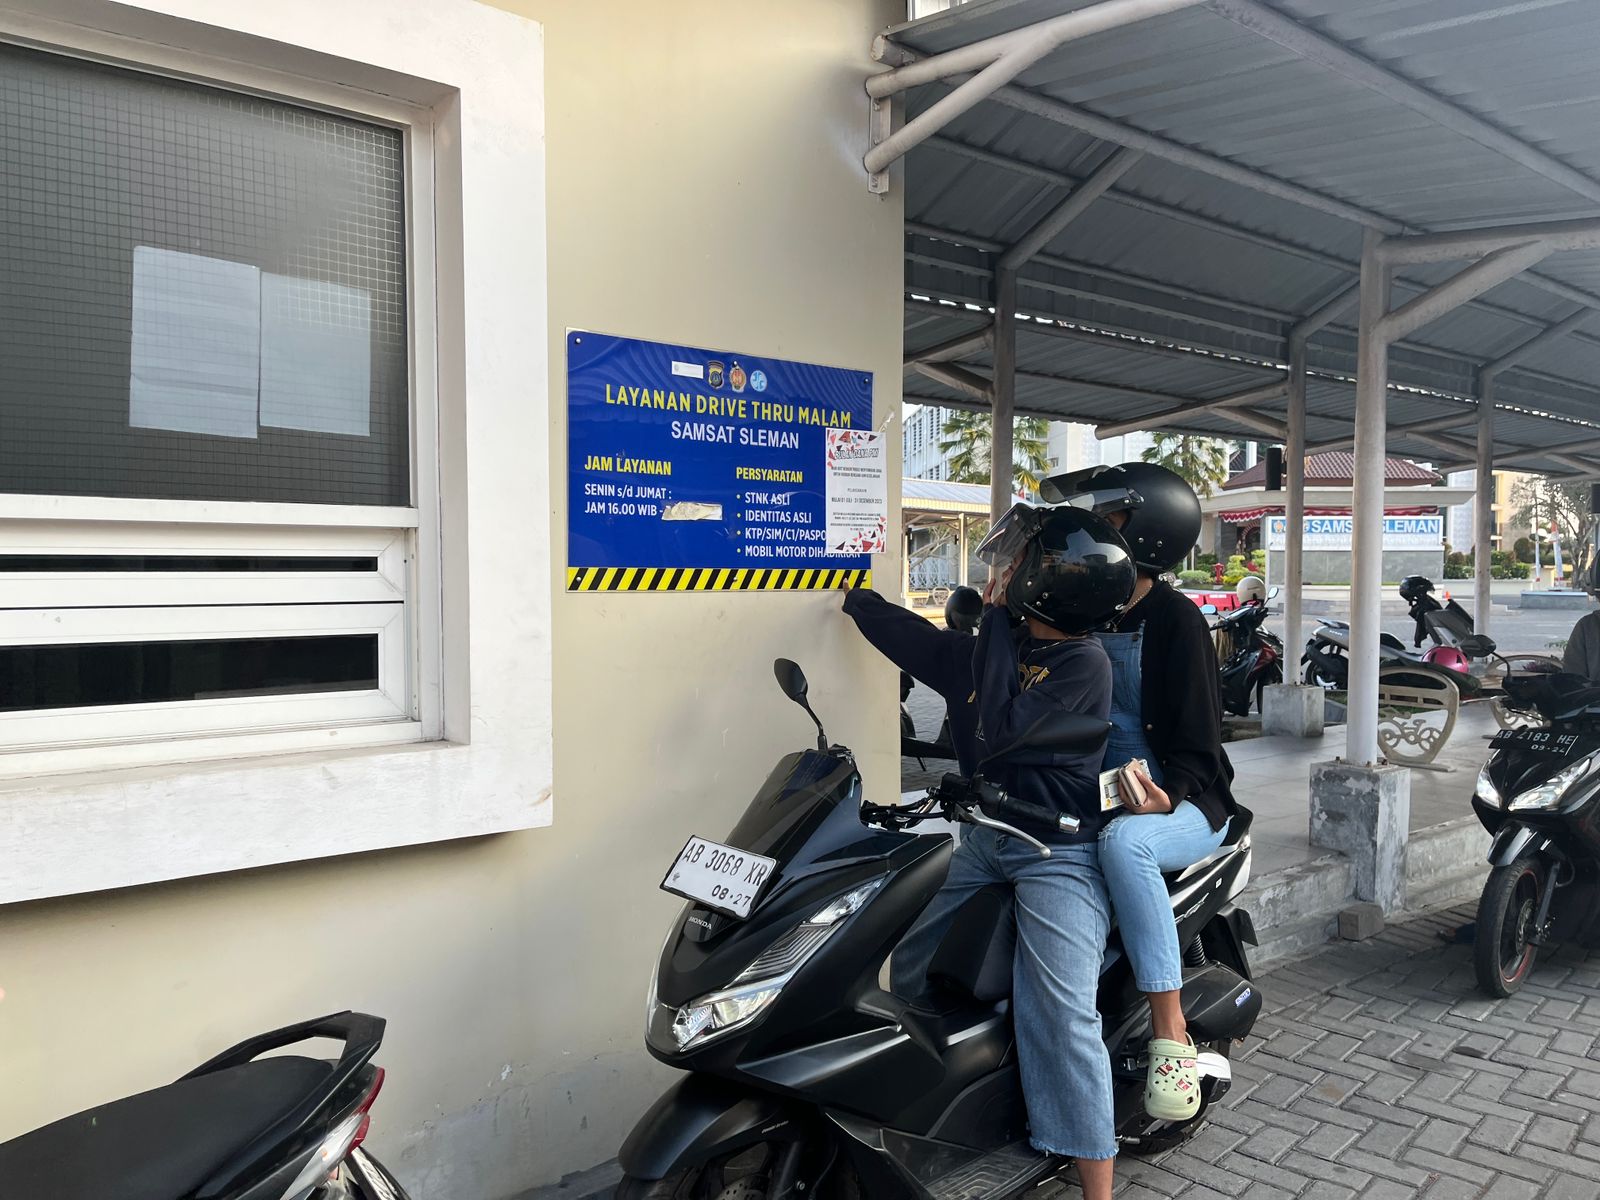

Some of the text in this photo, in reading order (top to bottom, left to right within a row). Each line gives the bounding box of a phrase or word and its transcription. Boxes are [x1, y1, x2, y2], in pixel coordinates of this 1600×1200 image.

[605, 383, 852, 429] LAYANAN DRIVE THRU MALAM
[671, 420, 800, 449] SAMSAT SLEMAN
[584, 455, 672, 475] JAM LAYANAN
[735, 466, 804, 483] PERSYARATAN
[584, 483, 615, 496] SENIN
[617, 484, 633, 499] s/d
[635, 486, 667, 500] JUMAT
[744, 492, 791, 506] STNK ASLI
[584, 501, 606, 514] JAM
[608, 503, 635, 516] 16.00
[637, 504, 657, 516] WIB
[744, 509, 812, 524] IDENTITAS ASLI
[1311, 519, 1353, 533] SAMS
[744, 527, 826, 542] KTP/SIM/C1/PASPO
[744, 545, 774, 557] MOBIL
[775, 545, 807, 558] MOTOR
[1556, 734, 1575, 745] HE
[682, 842, 768, 887] AB 3068 XR
[687, 916, 712, 930] HONDA
